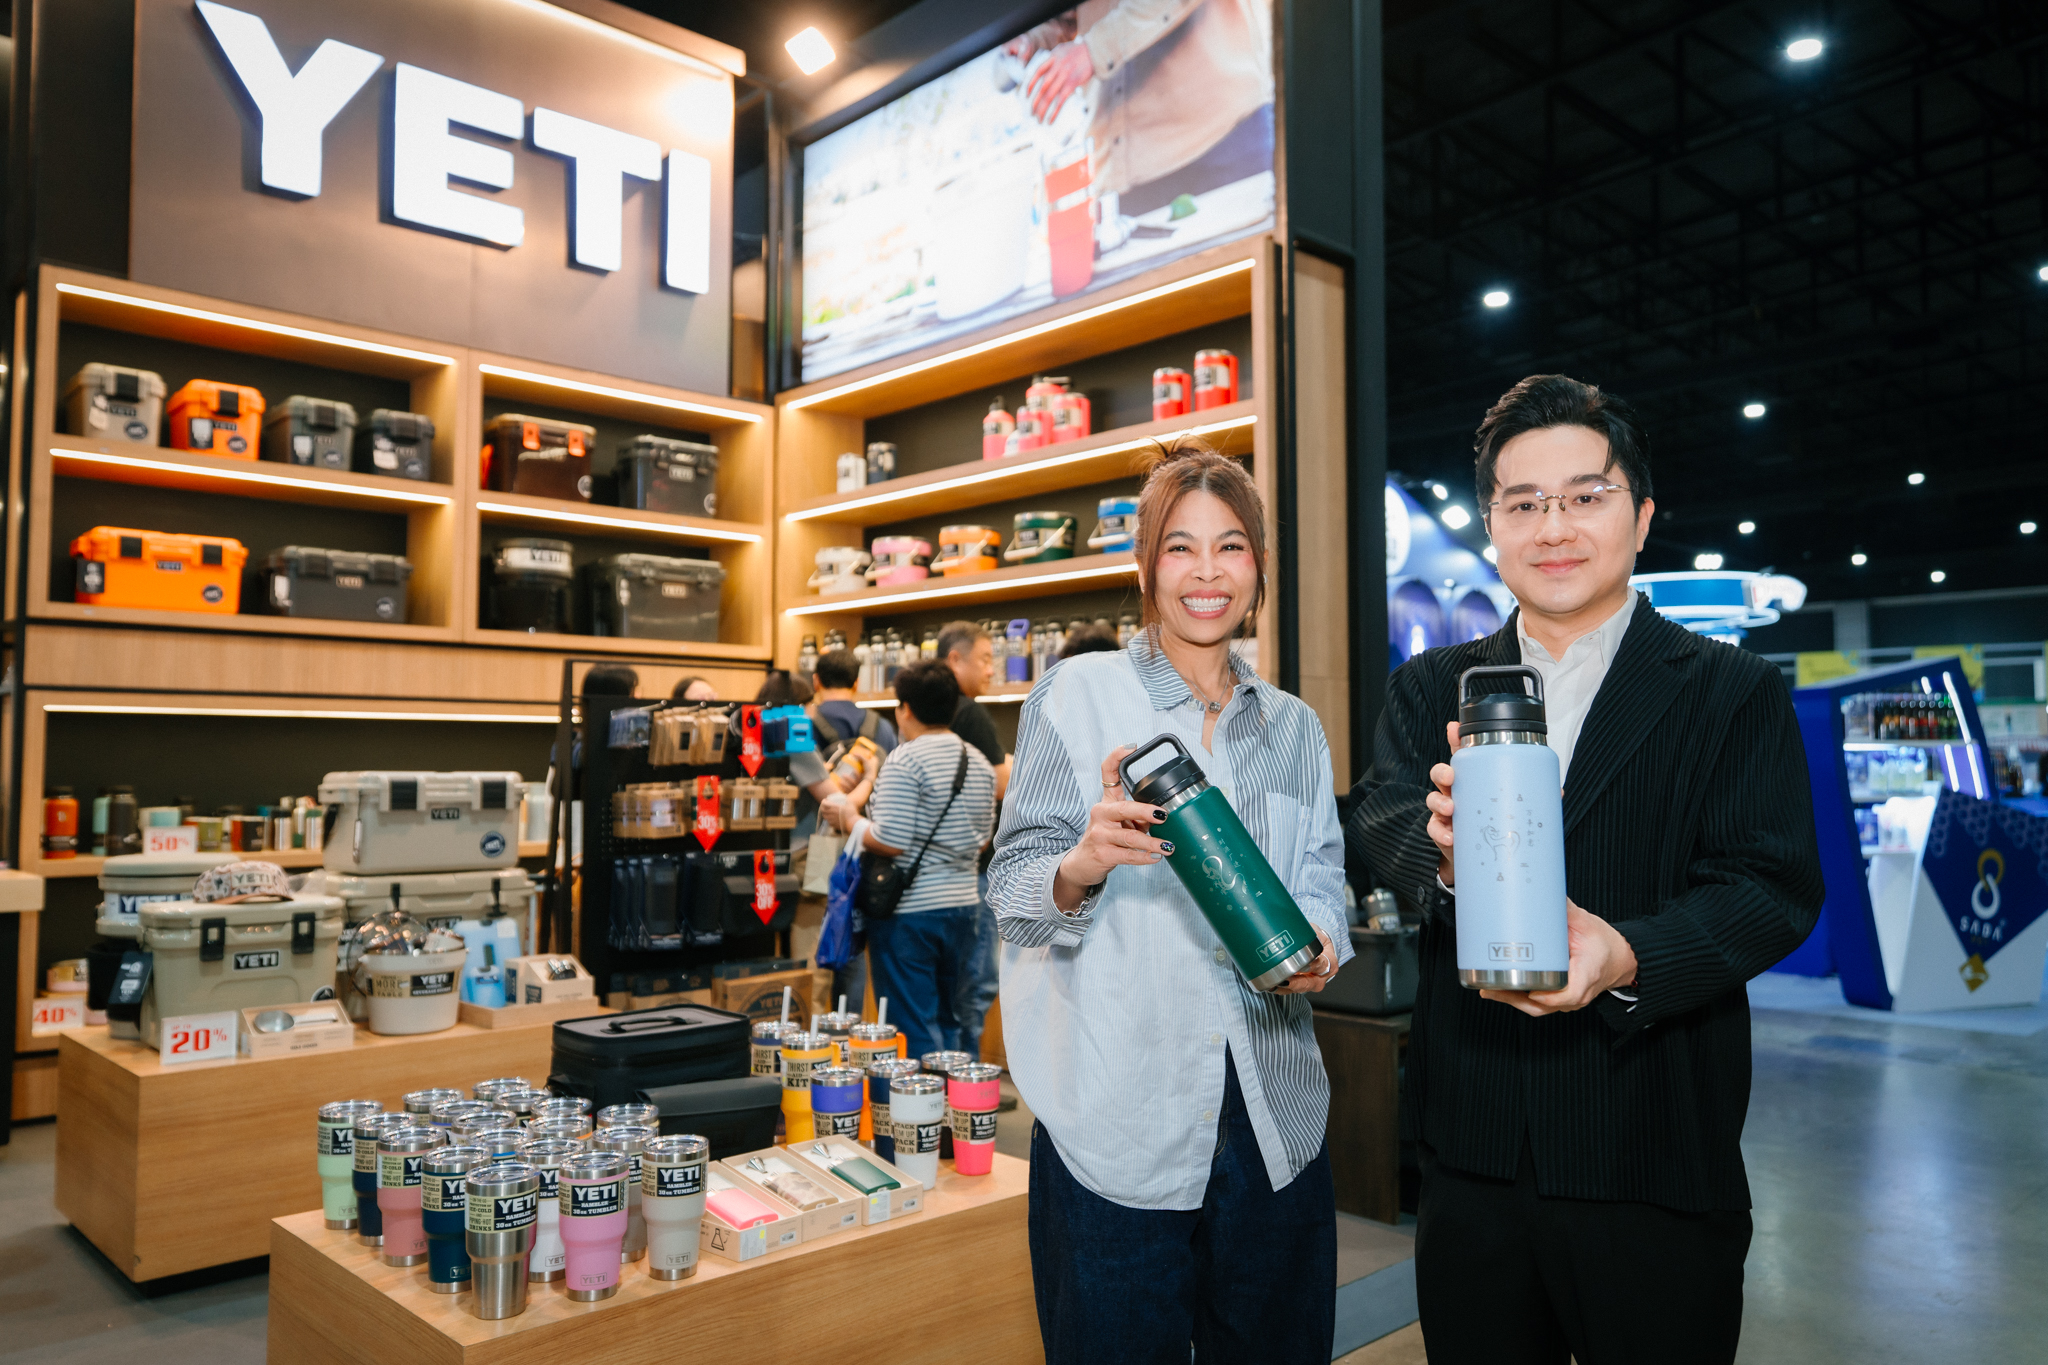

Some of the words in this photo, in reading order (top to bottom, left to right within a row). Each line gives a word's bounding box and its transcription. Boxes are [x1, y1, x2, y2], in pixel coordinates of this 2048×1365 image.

[194, 1, 712, 295] YETI
[432, 808, 458, 819] YETI
[151, 836, 189, 851] 50%
[233, 873, 273, 883] YETI
[1260, 934, 1290, 958] YETI
[1492, 946, 1530, 958] YETI
[236, 954, 277, 968] YETI
[420, 973, 449, 985] YETI
[34, 1007, 77, 1023] 40%
[170, 1028, 227, 1054] 20%
[787, 1062, 808, 1072] THIRST
[787, 1078, 808, 1088] KIT
[659, 1165, 700, 1183] YETI
[574, 1183, 618, 1202] YETI
[673, 1185, 700, 1195] TUMBLER
[498, 1191, 536, 1214] YETI
[581, 1200, 609, 1208] RAMBLER
[587, 1204, 617, 1215] TUMBLER
[667, 1255, 689, 1264] YETI
[582, 1275, 606, 1285] YETI
